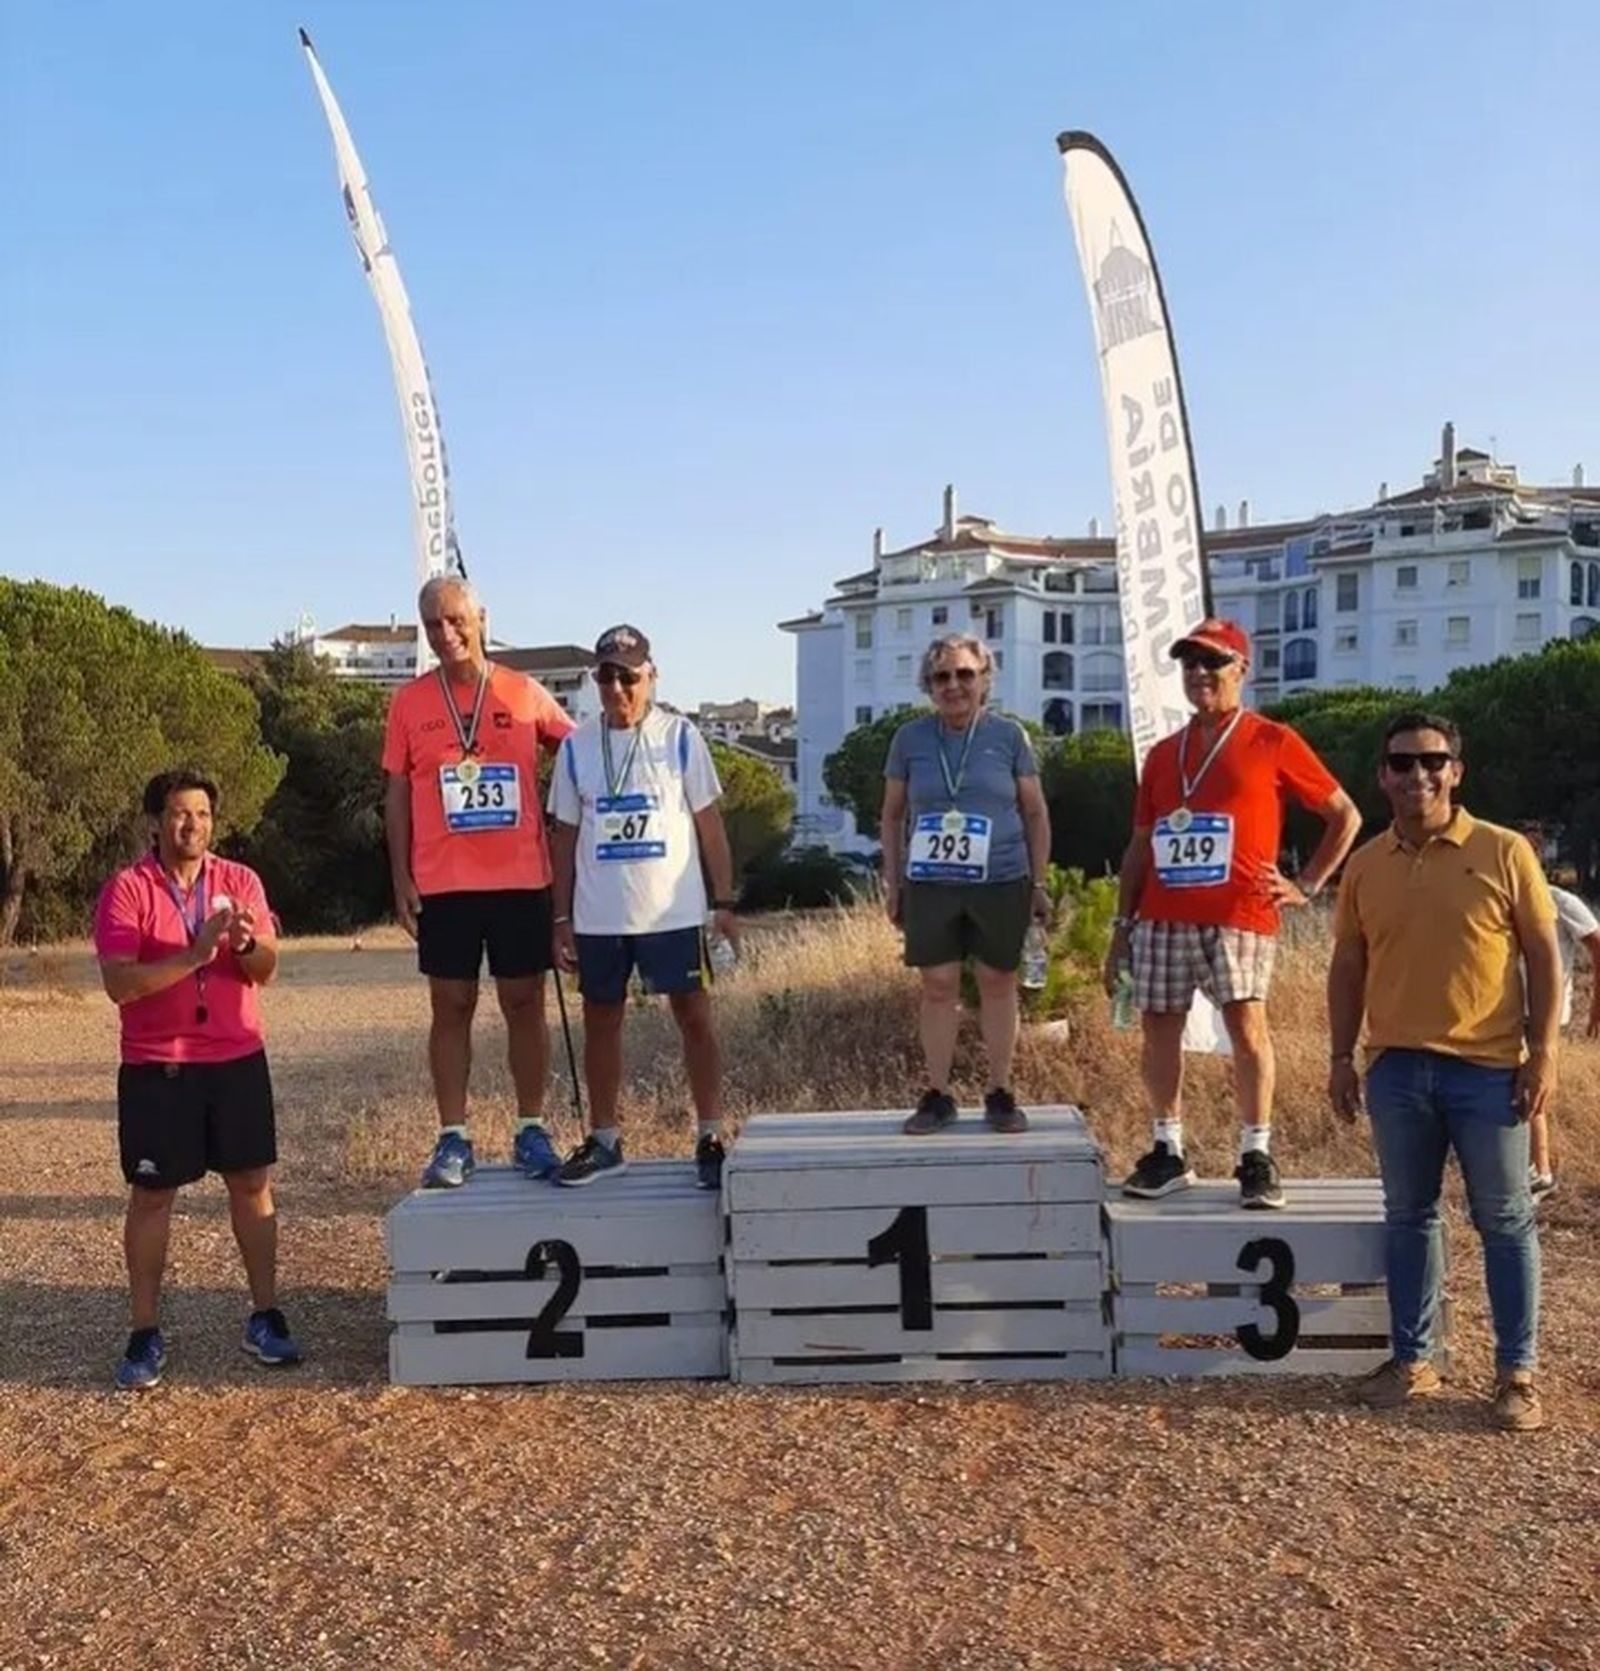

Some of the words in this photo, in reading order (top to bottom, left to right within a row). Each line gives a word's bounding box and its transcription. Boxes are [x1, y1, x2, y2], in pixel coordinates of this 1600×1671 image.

[461, 782, 505, 810] 253
[611, 814, 649, 841] 67
[928, 833, 971, 861] 293
[1168, 835, 1215, 864] 249
[867, 1205, 933, 1332] 1
[524, 1238, 584, 1359] 2
[1235, 1237, 1300, 1361] 3
